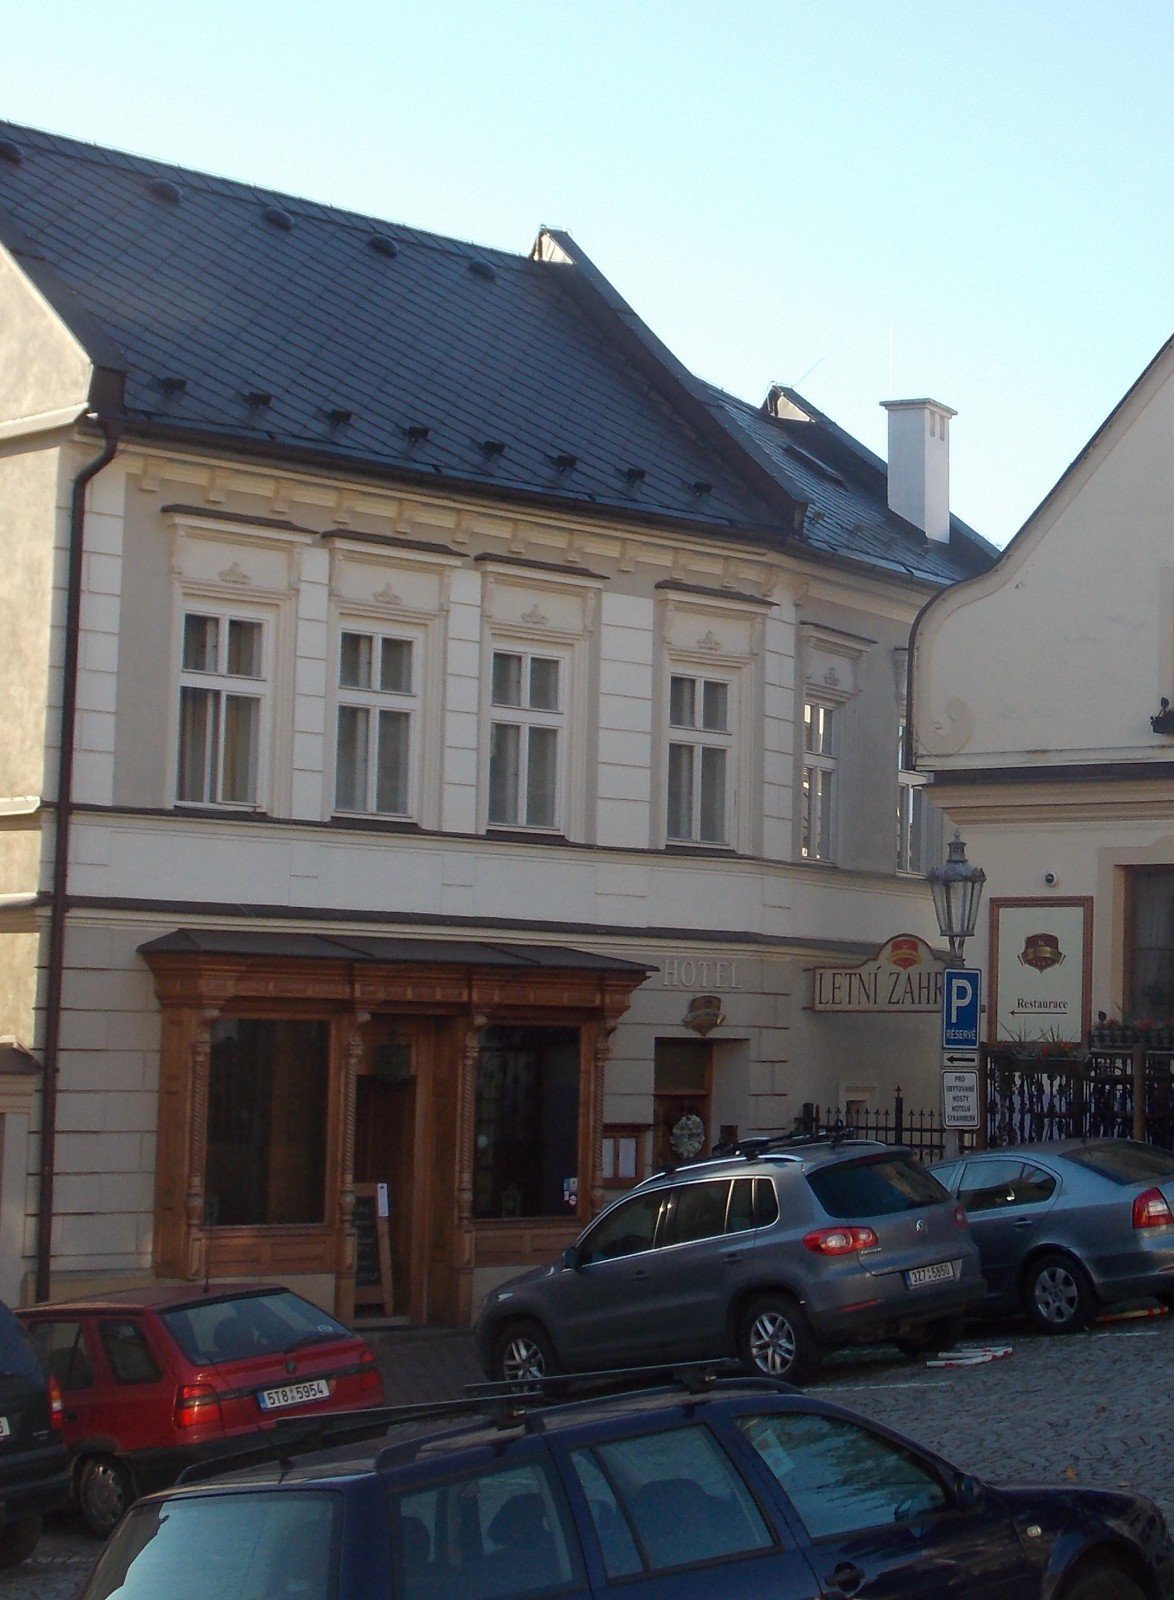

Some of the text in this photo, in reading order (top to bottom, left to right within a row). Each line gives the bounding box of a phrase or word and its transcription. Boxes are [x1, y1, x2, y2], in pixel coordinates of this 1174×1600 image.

[662, 959, 742, 989] HOTEL
[818, 967, 881, 1005] LETNÍ
[951, 979, 973, 1024] P
[1017, 998, 1068, 1009] Restaurace
[954, 1075, 966, 1083] PRO
[267, 1381, 324, 1406] 5T8 5954
